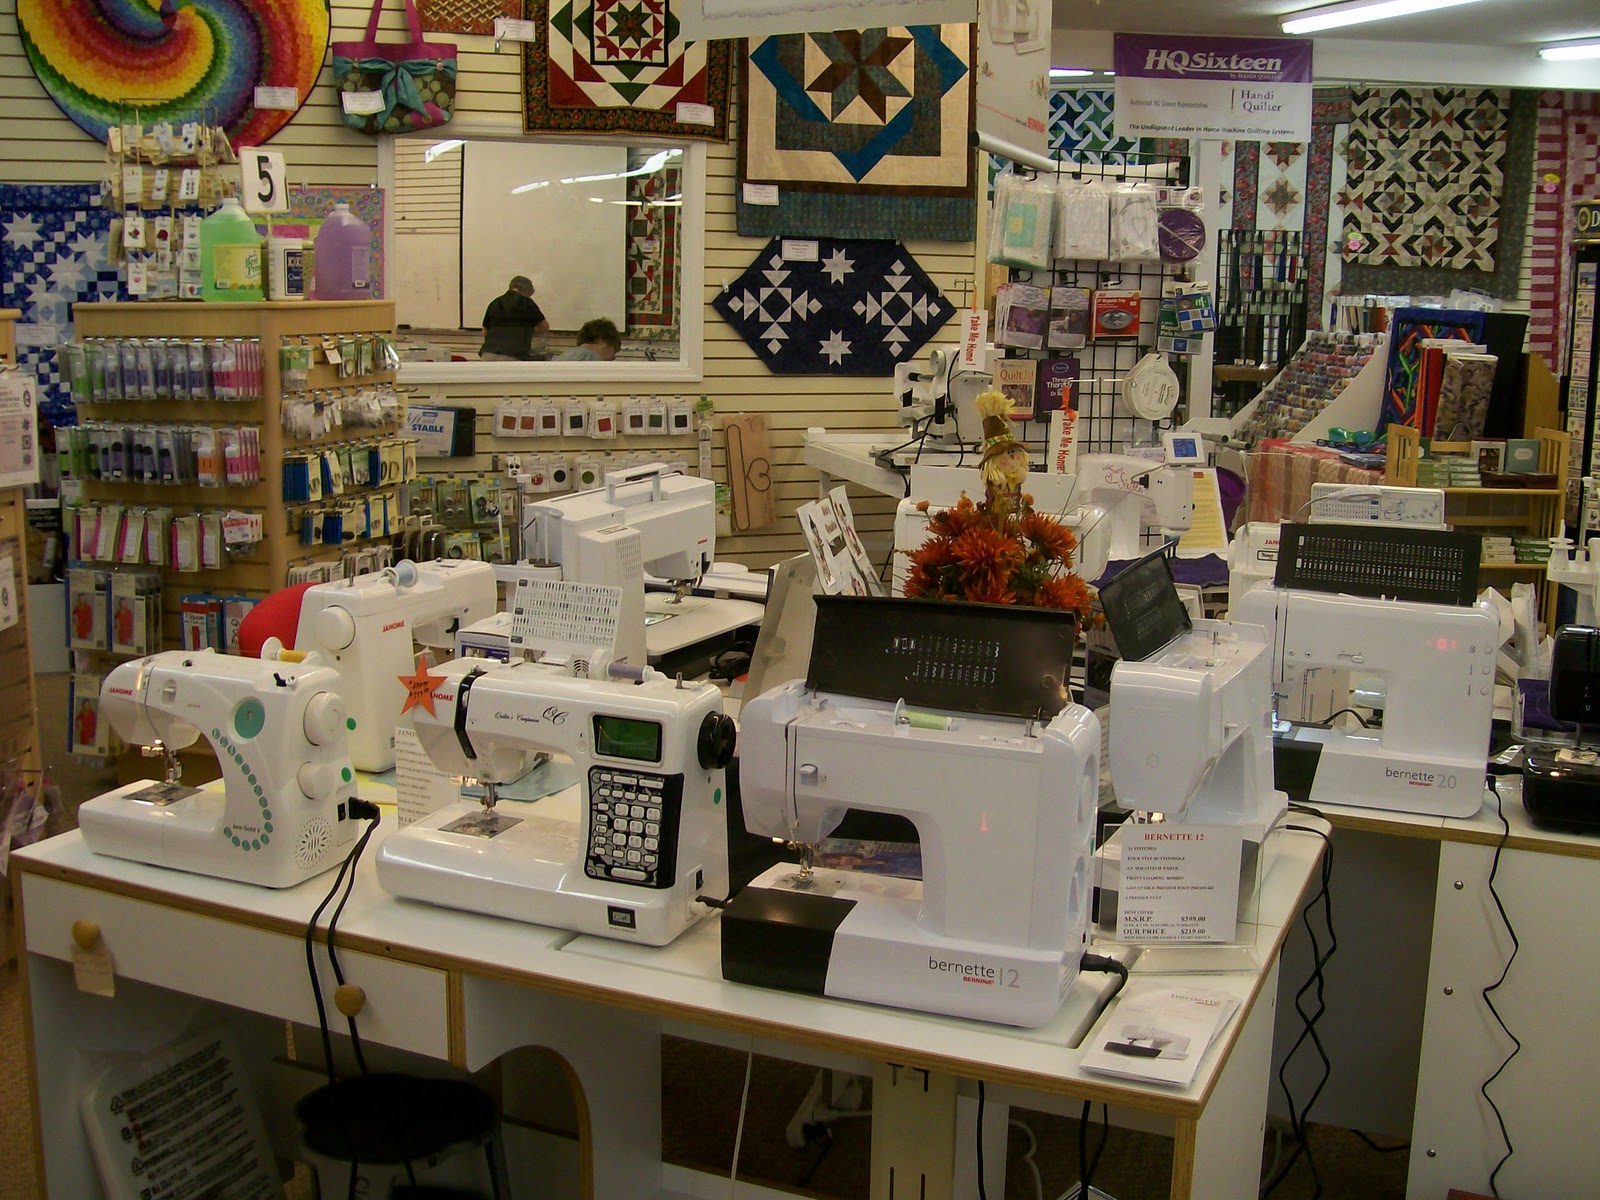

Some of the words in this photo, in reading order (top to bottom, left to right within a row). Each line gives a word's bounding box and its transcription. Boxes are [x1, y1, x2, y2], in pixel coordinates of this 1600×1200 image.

[1241, 89, 1275, 100] Handi
[1243, 101, 1282, 113] Quilter
[1246, 128, 1270, 136] Quilting
[256, 155, 274, 203] 5
[970, 316, 980, 331] Take
[968, 332, 980, 342] Me
[1000, 369, 1022, 382] Quilt
[412, 424, 444, 433] STABLE
[1062, 418, 1075, 436] Take
[1060, 437, 1073, 449] Me
[382, 620, 406, 632] JANOME
[109, 687, 133, 696] JANOME
[432, 692, 454, 702] NOME
[1386, 766, 1434, 782] bernette
[1437, 774, 1457, 790] 20
[928, 956, 996, 978] bernette
[999, 968, 1020, 988] 12
[962, 976, 995, 986] BERNINA
[1170, 993, 1221, 1005] bernette
